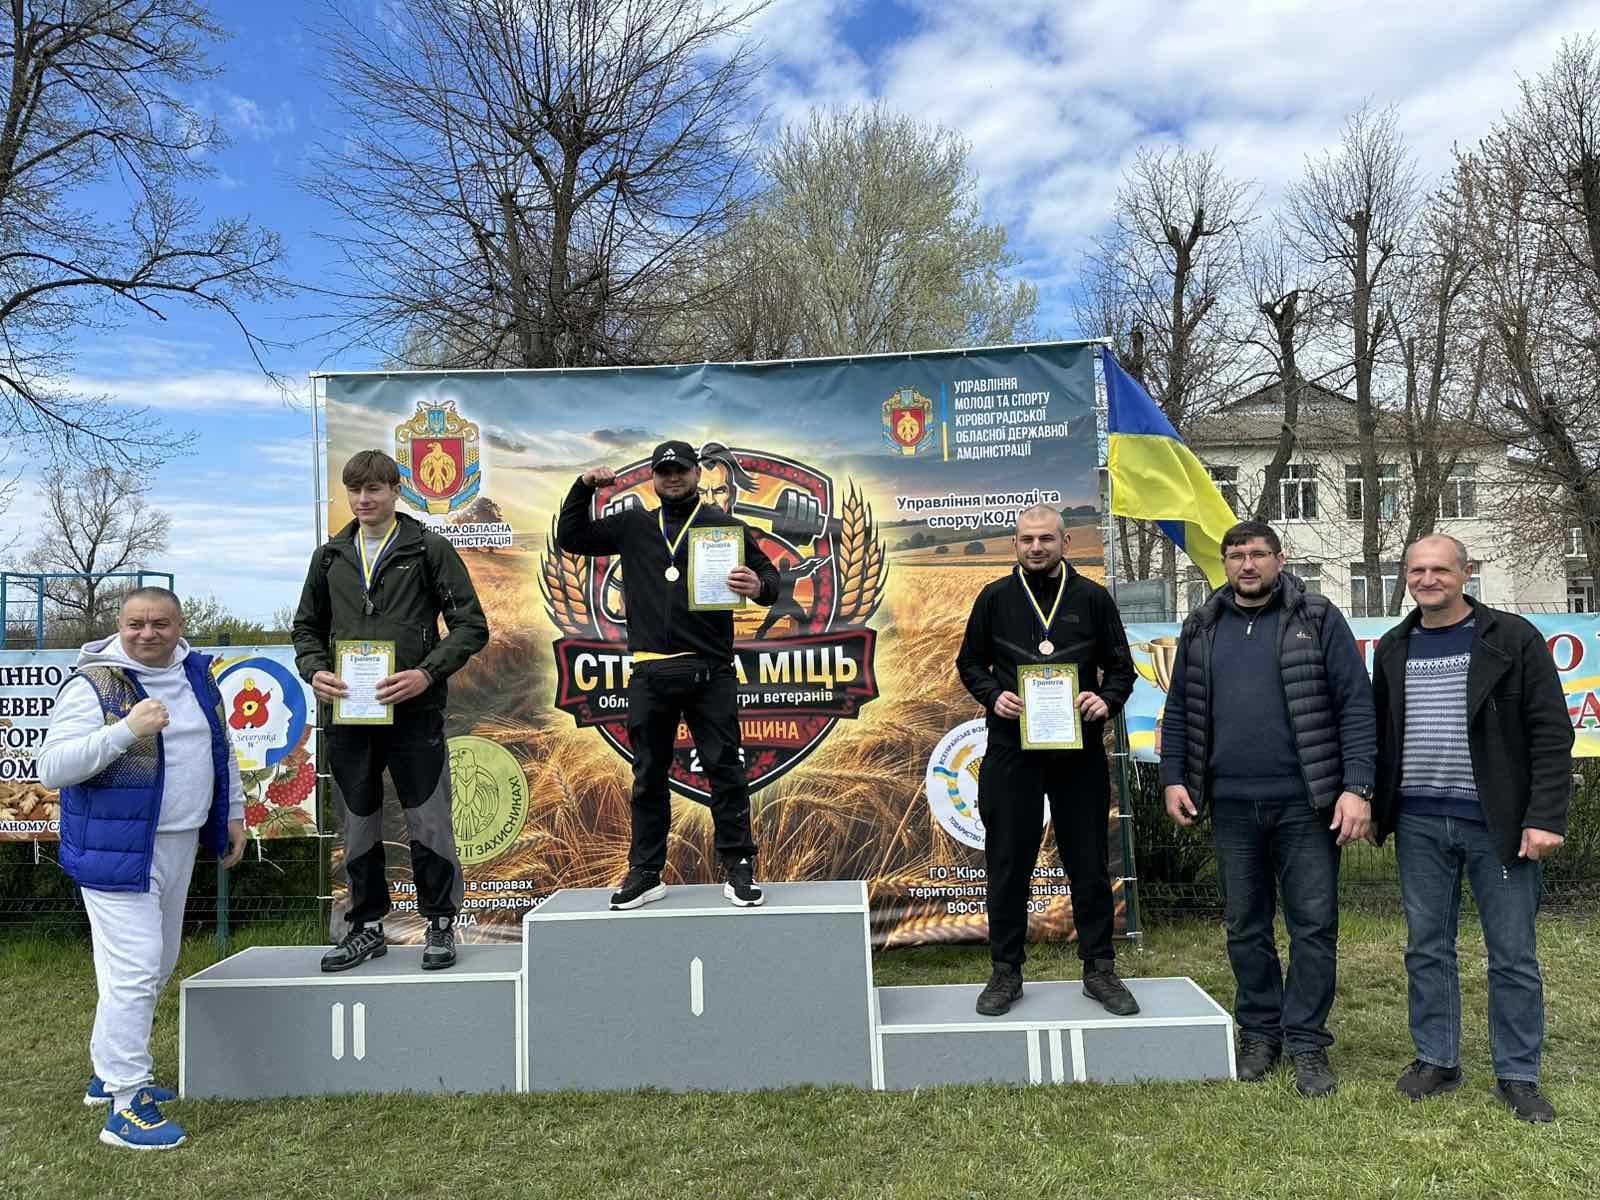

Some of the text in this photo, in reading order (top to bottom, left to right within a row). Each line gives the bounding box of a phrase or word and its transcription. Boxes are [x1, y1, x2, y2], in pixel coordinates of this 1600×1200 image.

[954, 377, 1018, 394] УПРАВЛІННЯ
[954, 391, 1050, 411] МОЛОДІ ТА СПОРТУ
[955, 407, 1047, 427] КІРОВОГРАДСЬКОЇ
[956, 421, 1069, 444] ОБЛАСНОЇ ДЕРЖАВНОЇ
[956, 441, 1031, 461] АМДІНІСТРАЦІЇ
[897, 490, 1060, 511] Управління молоді та
[462, 524, 511, 534] ОБЛАСНА
[929, 514, 979, 529] спорту
[450, 536, 511, 546] ІНІСТРАЦІЯ
[759, 646, 858, 688] МІЦЬ
[736, 693, 761, 707] гри
[763, 688, 833, 704] ветеранів
[0, 822, 46, 832] АНОМУ
[929, 867, 947, 879] ГО
[481, 879, 533, 893] справах
[463, 895, 549, 911] овоградсько
[947, 901, 986, 914] ВФСТ
